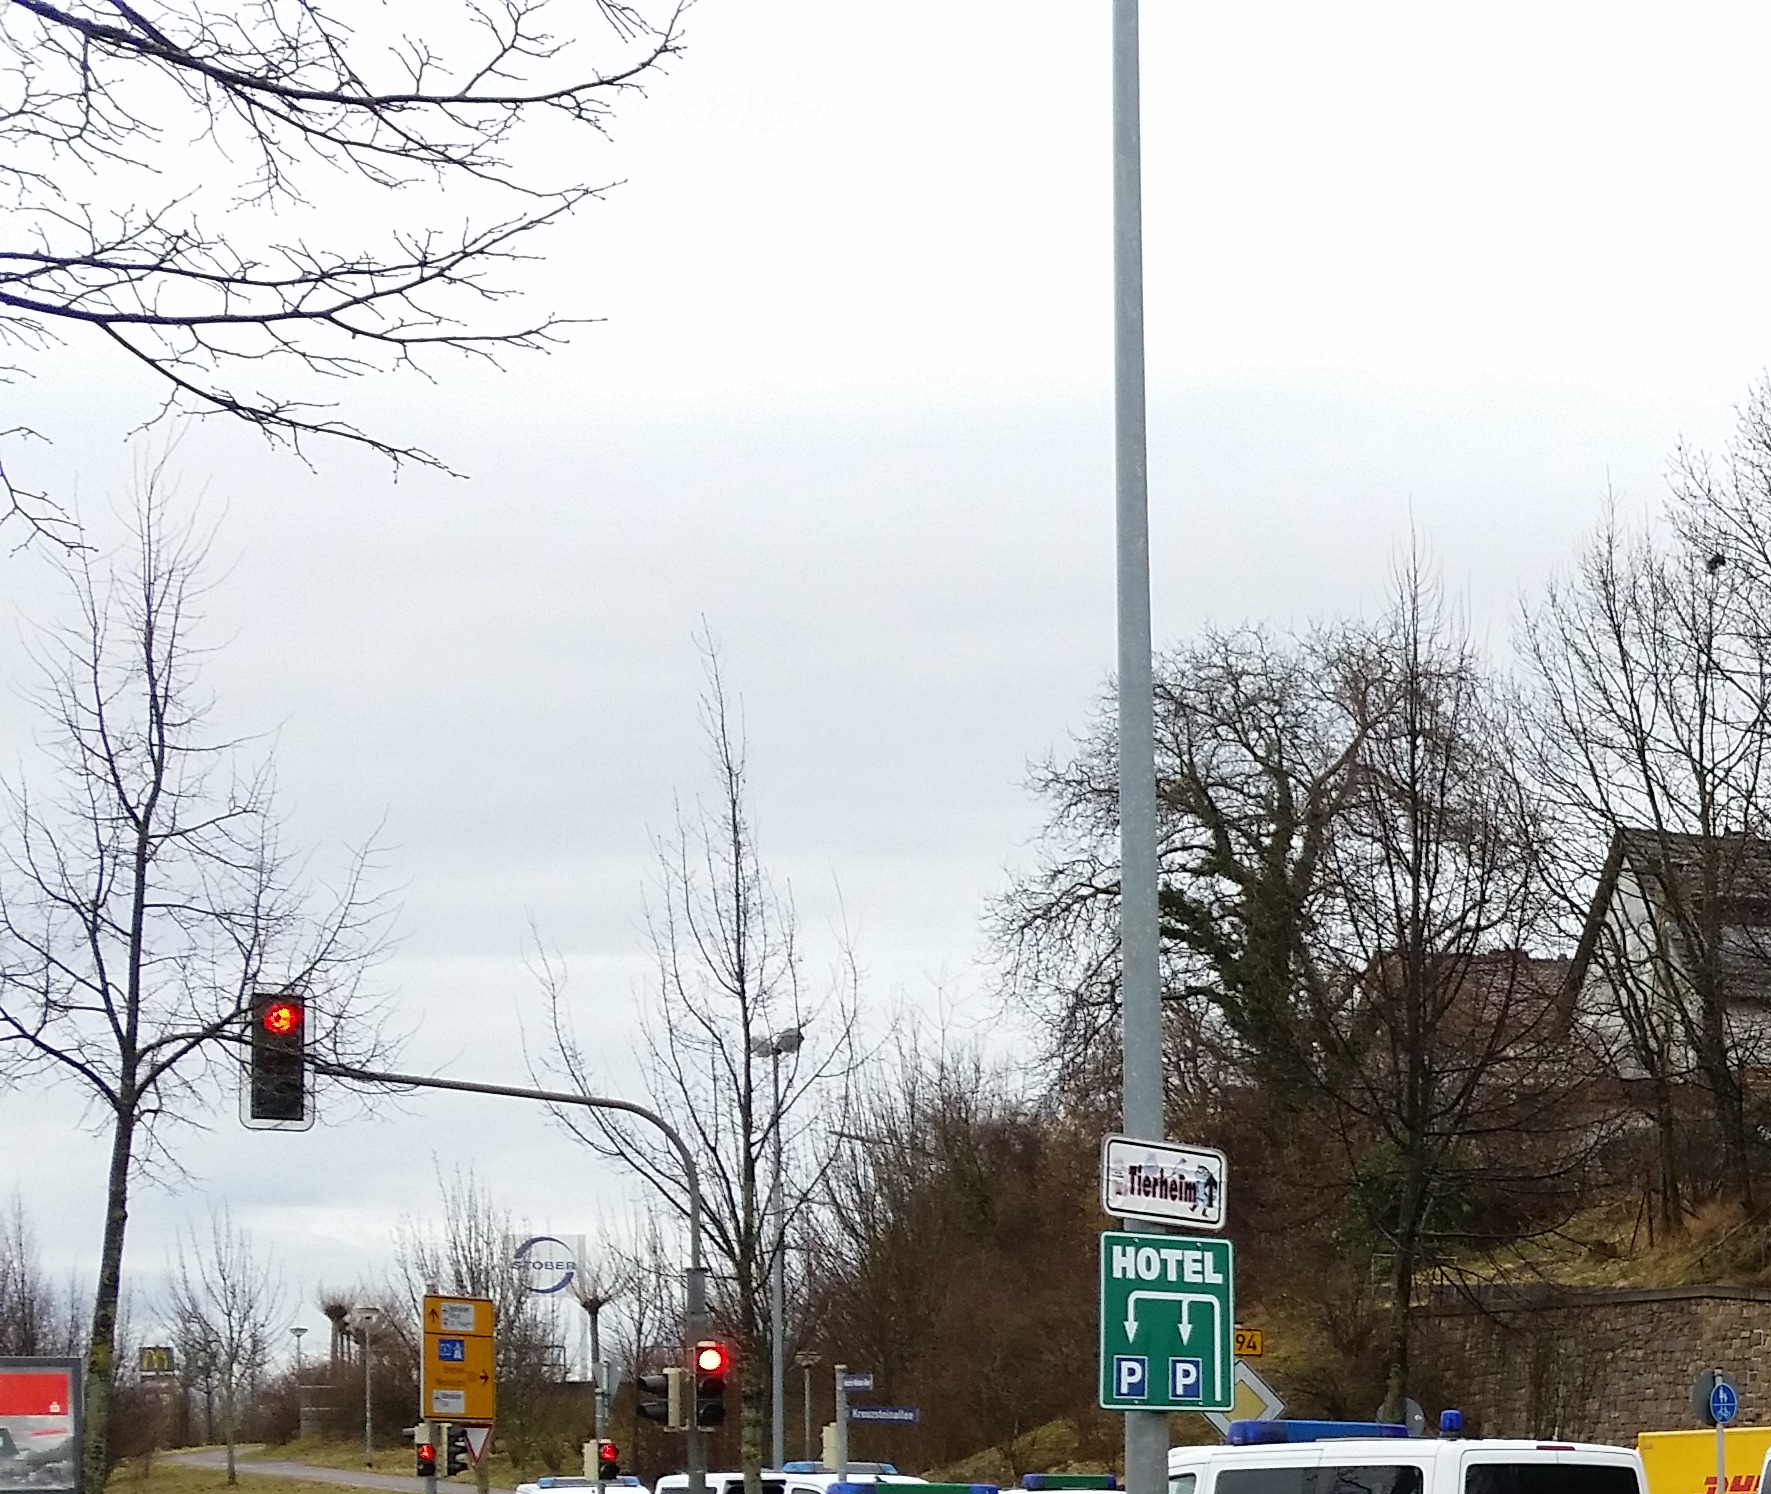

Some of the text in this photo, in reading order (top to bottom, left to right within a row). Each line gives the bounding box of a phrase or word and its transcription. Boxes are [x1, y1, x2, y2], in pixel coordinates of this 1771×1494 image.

[1128, 1165, 1198, 1204] Tierheim
[1112, 1245, 1224, 1284] HOTEL
[1235, 1333, 1257, 1350] 94
[1120, 1360, 1197, 1395] P P
